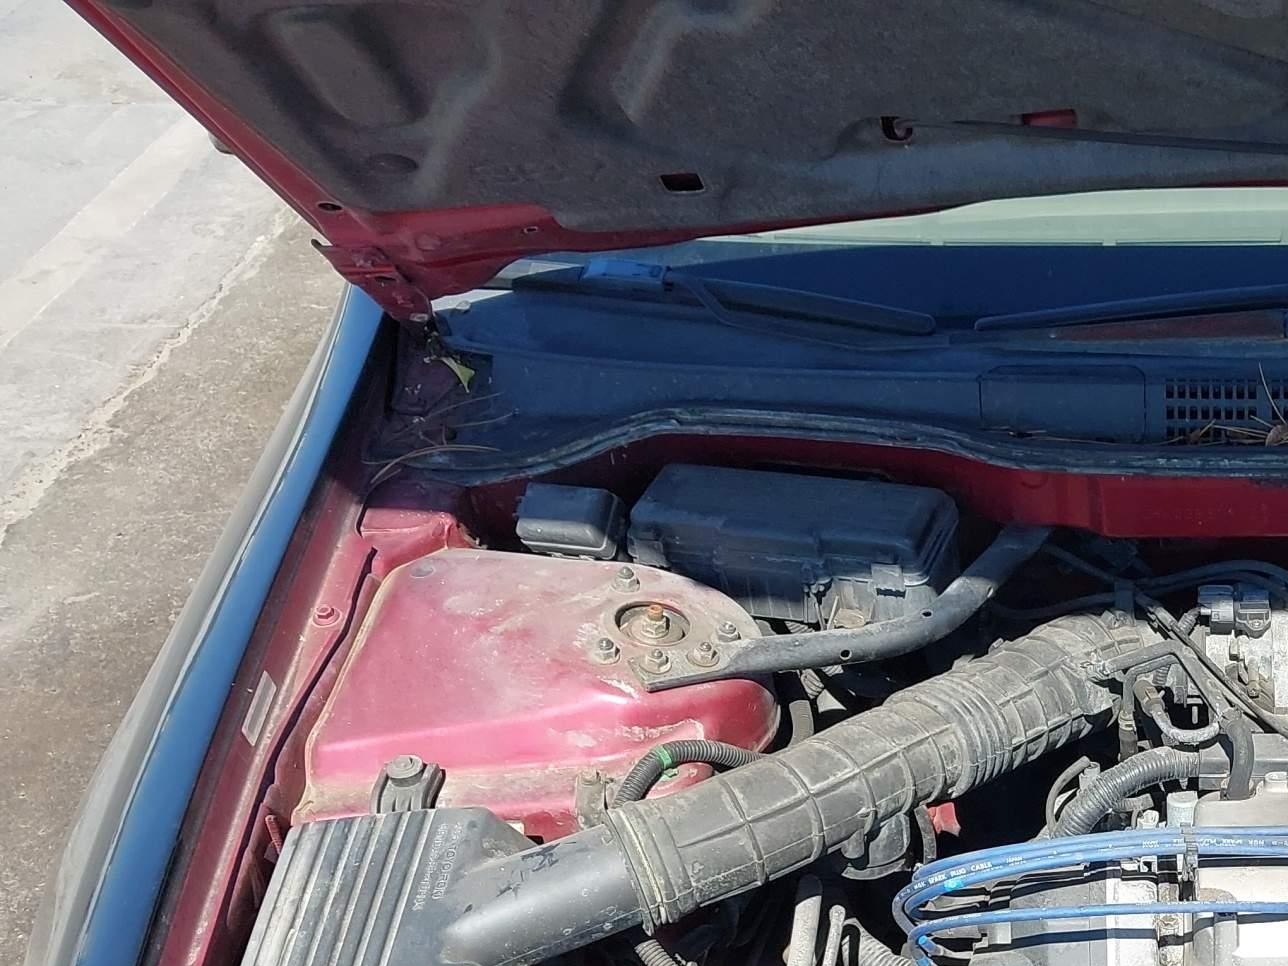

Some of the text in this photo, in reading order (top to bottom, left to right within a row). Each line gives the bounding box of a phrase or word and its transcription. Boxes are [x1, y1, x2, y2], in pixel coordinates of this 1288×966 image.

[928, 872, 948, 885] SPARK
[950, 866, 967, 878] PLUG
[970, 861, 993, 873] CABLE
